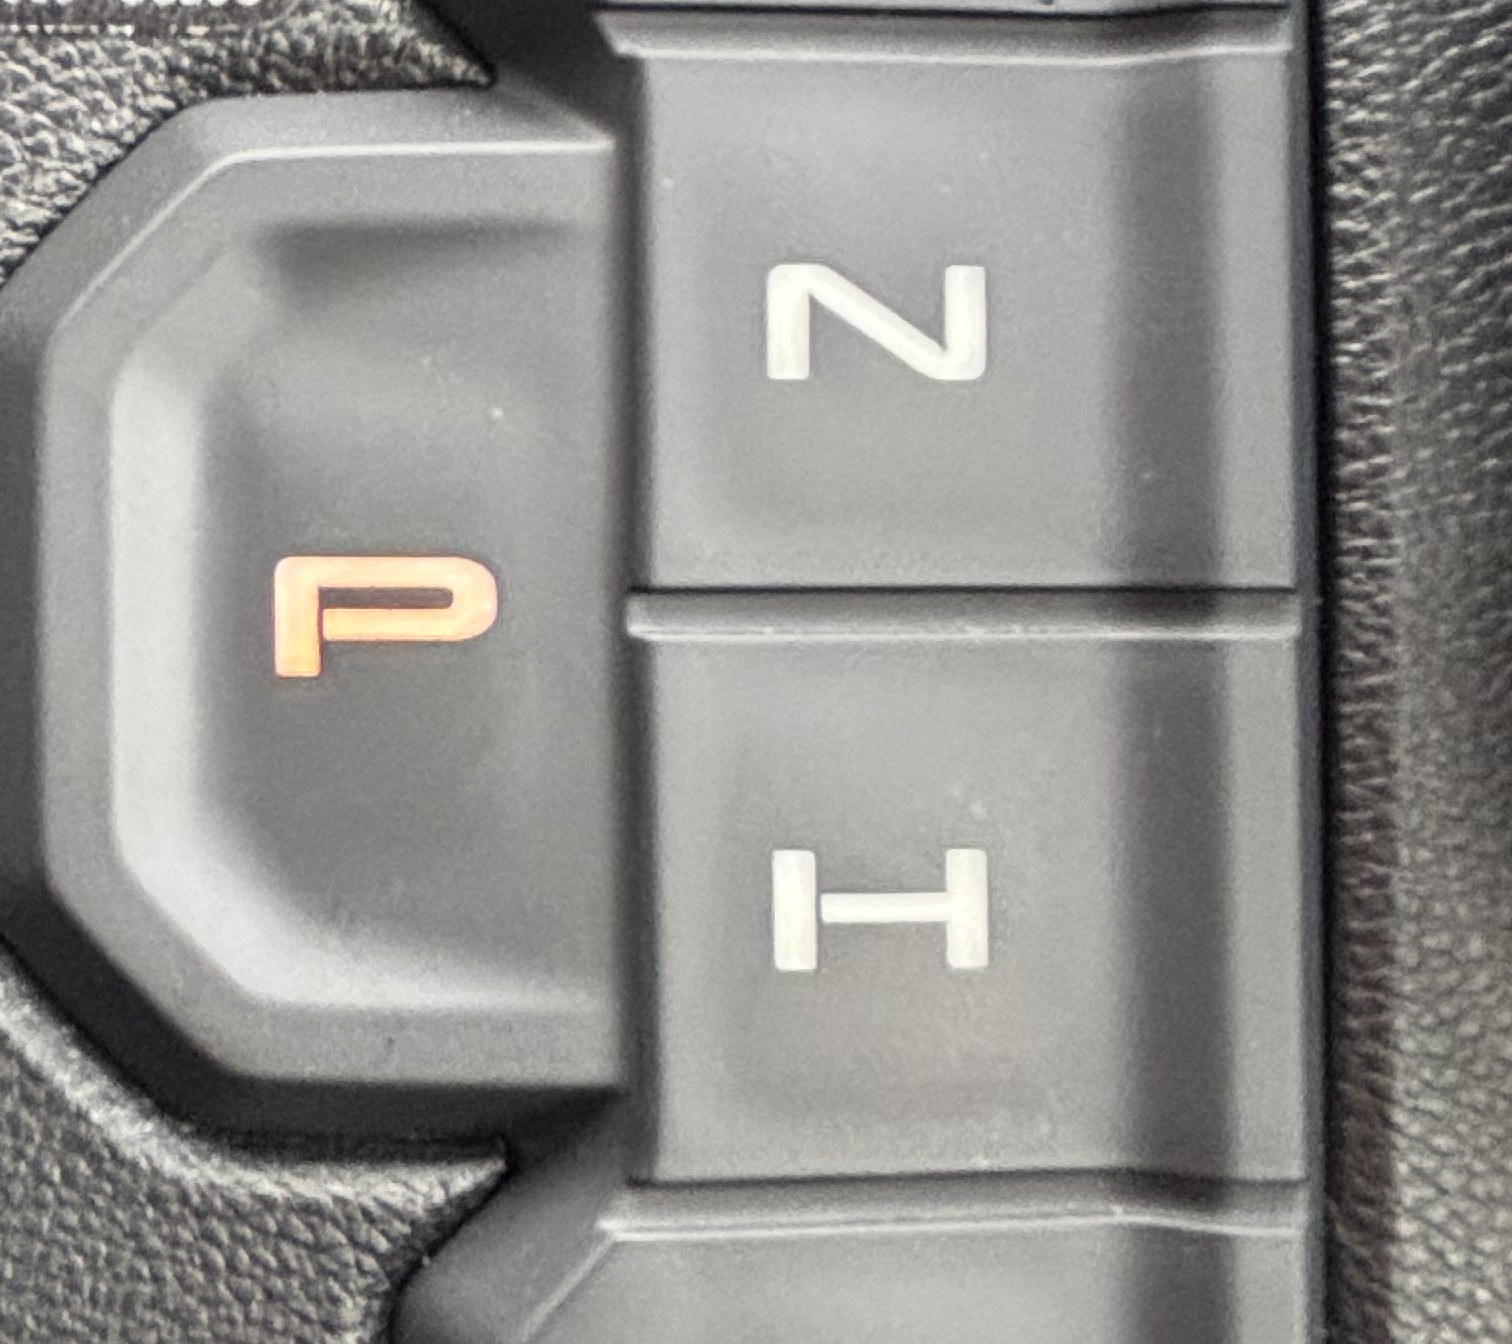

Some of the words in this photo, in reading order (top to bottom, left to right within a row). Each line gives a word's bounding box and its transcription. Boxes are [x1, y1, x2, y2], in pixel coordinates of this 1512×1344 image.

[767, 264, 986, 381] N
[274, 557, 497, 677] P
[773, 849, 988, 971] H
